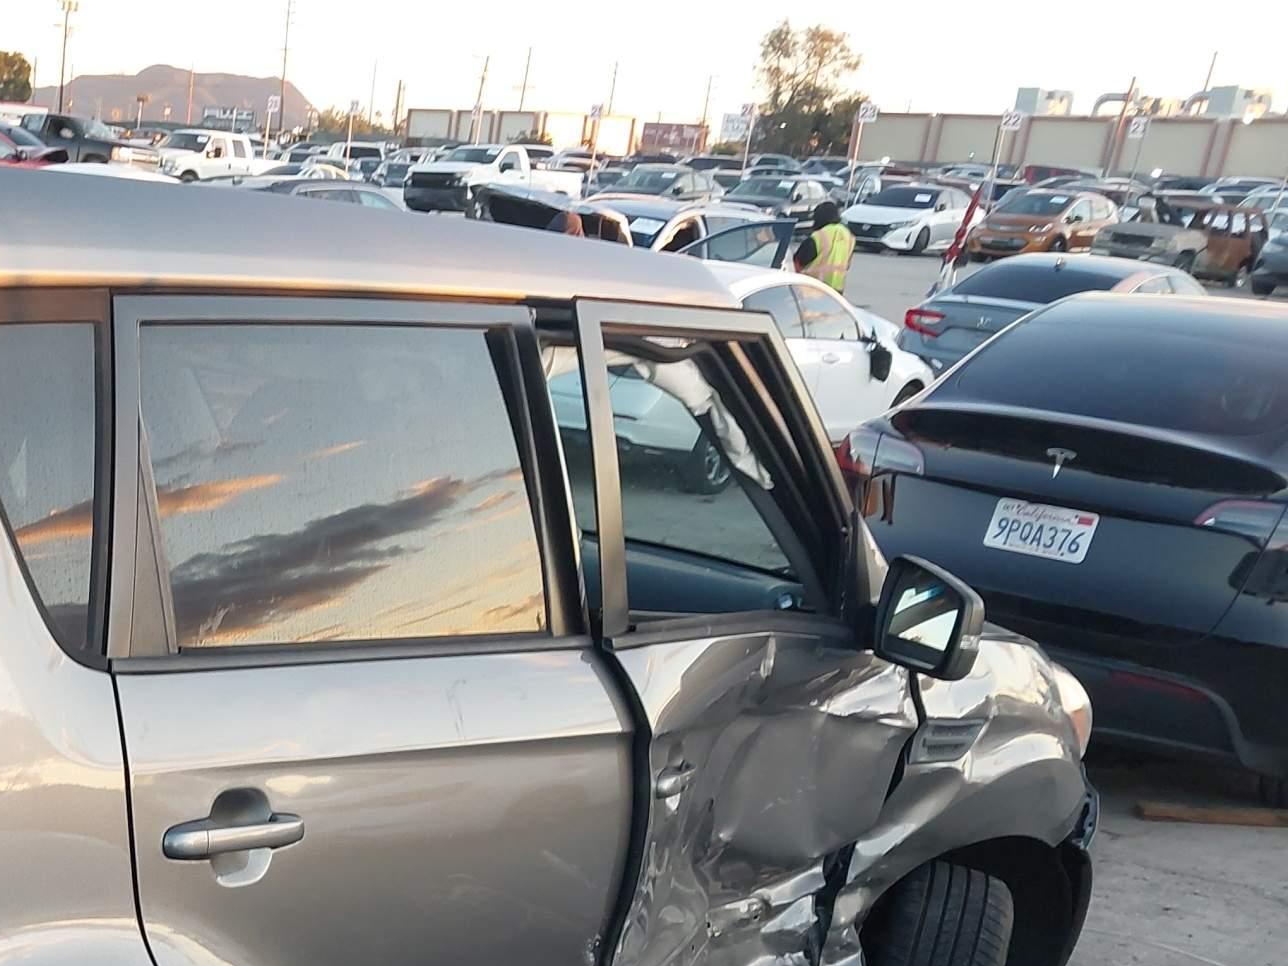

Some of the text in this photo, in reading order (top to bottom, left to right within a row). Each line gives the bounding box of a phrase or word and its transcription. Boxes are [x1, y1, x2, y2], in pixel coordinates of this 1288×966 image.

[860, 105, 876, 118] 23
[1003, 112, 1020, 126] 22
[1016, 502, 1073, 523] California
[993, 517, 1086, 554] 9PQA376
